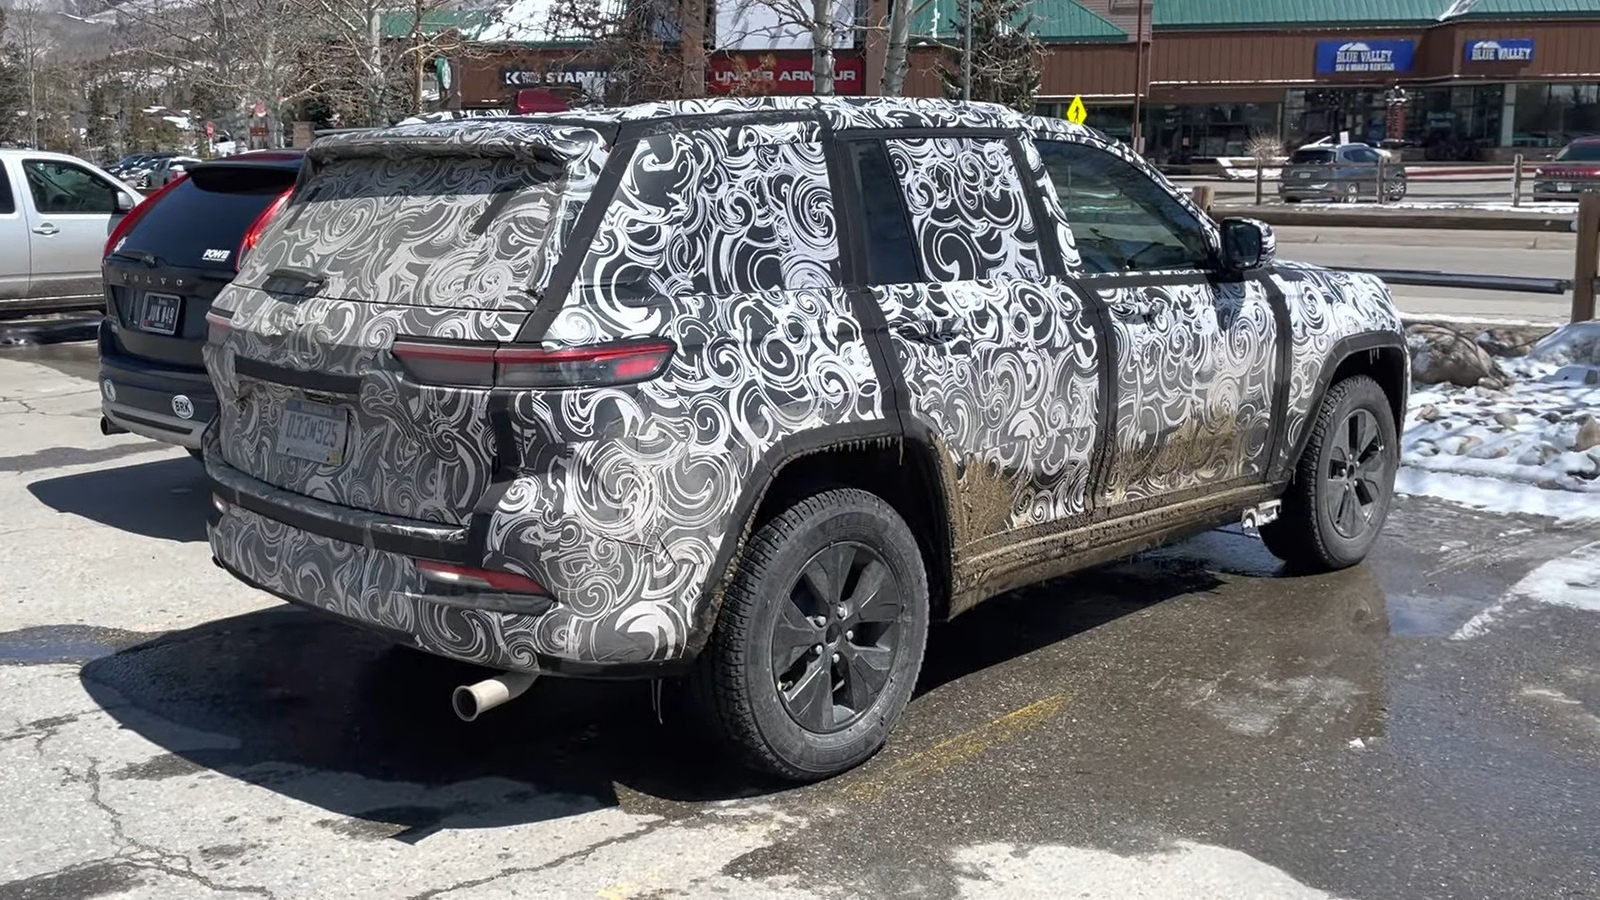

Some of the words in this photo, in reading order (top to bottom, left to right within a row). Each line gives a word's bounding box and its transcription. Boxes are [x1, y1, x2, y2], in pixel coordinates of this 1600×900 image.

[1336, 51, 1359, 63] BLUE
[1360, 50, 1393, 62] VALLEY
[1472, 48, 1495, 60] BLUE
[1497, 47, 1532, 60] VALLEY
[779, 70, 856, 81] ARMUR
[123, 272, 183, 286] VOLVO
[175, 400, 191, 413] BRK
